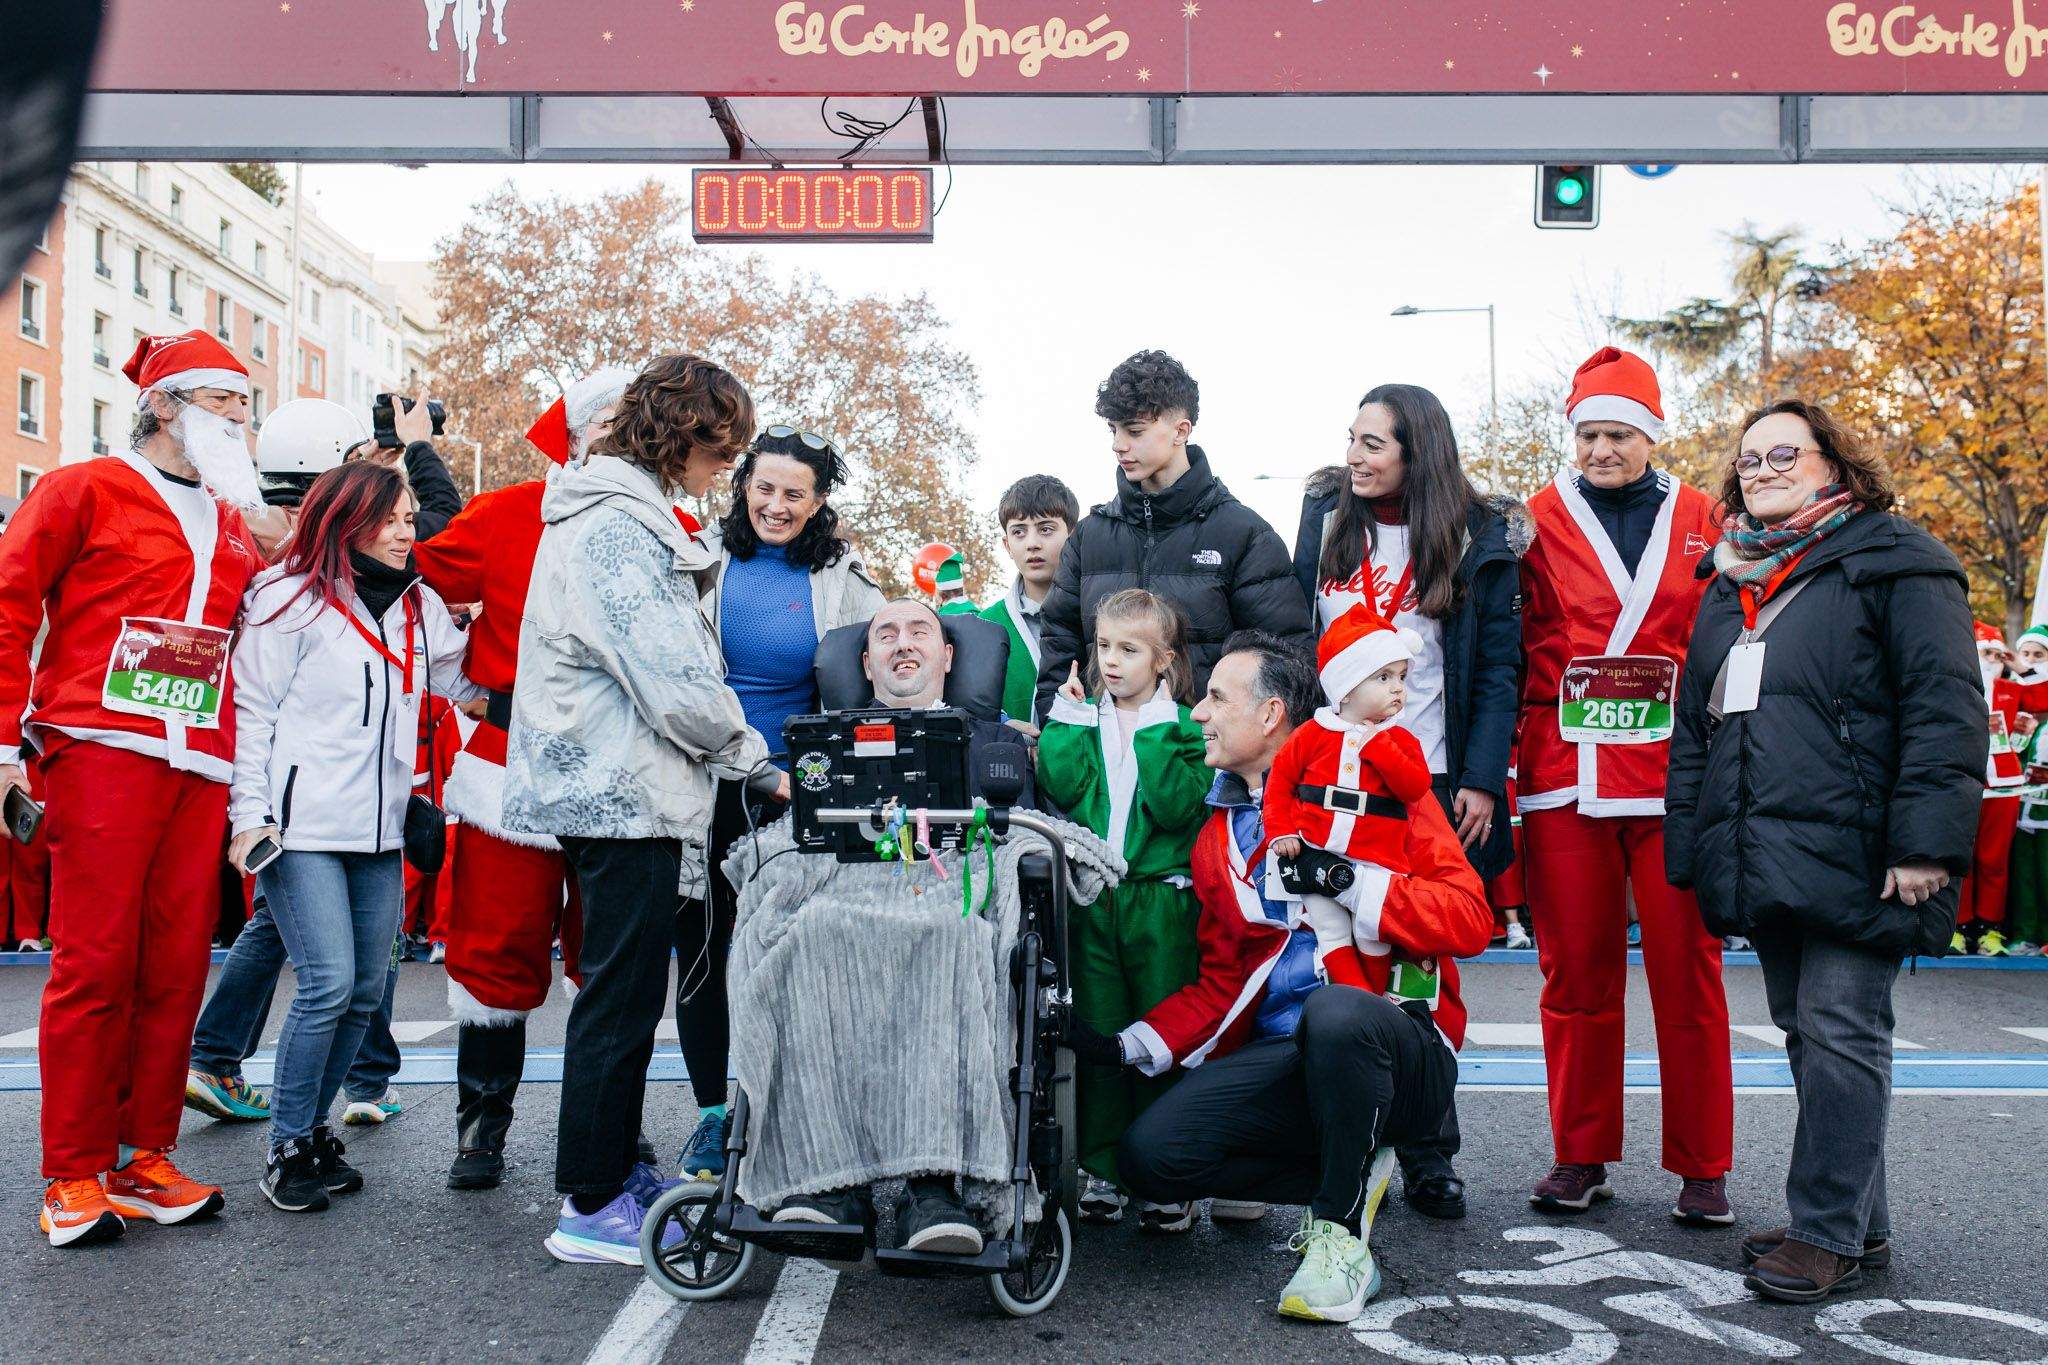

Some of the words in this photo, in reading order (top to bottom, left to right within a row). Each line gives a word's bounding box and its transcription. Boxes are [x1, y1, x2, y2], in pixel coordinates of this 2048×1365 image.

[775, 2, 828, 56] El
[830, 4, 950, 57] Corte
[956, 0, 1129, 78] Inglés
[1826, 3, 1879, 56] El
[1881, 4, 1999, 57] Corte
[699, 175, 922, 230] 00:00:00
[160, 637, 192, 654] Papá
[195, 643, 218, 658] Noel
[1599, 666, 1629, 680] Papá
[1632, 666, 1660, 677] Noel
[130, 671, 205, 710] 5480
[1582, 700, 1651, 728] 2667
[989, 763, 1019, 779] JBL
